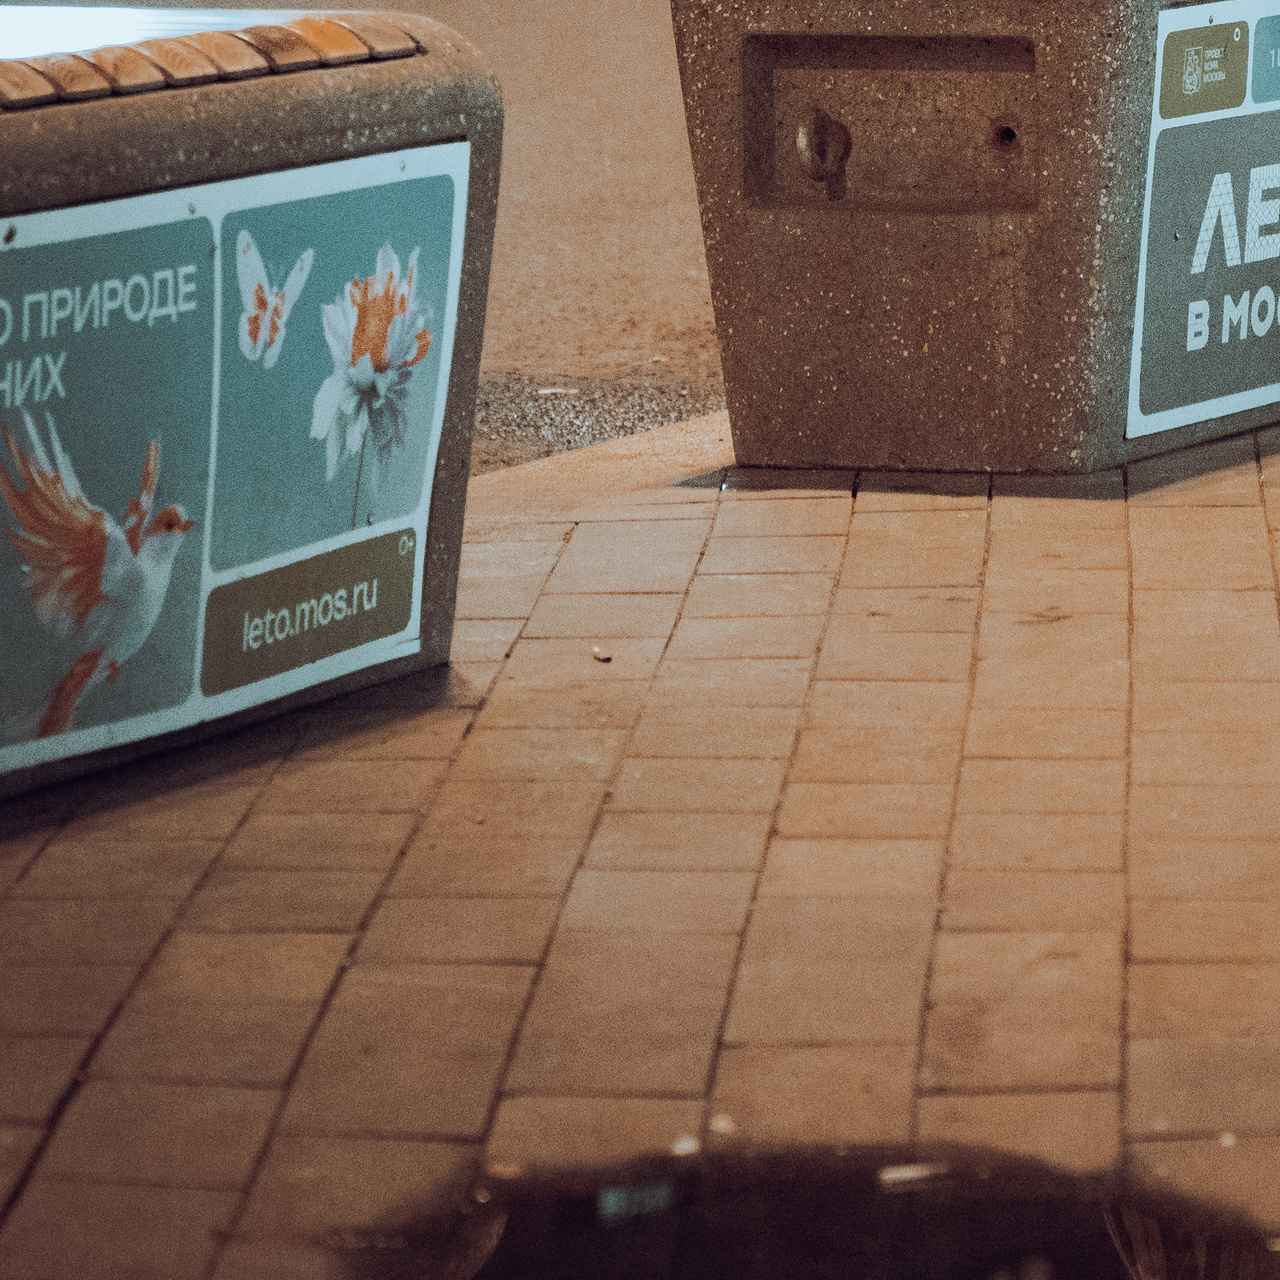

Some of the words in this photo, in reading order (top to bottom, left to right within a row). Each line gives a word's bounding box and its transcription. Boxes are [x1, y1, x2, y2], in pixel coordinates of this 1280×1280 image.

[21, 264, 198, 343] ПРИРОДЕ
[1186, 299, 1210, 352] В
[242, 577, 379, 652] leto.mos.ru
